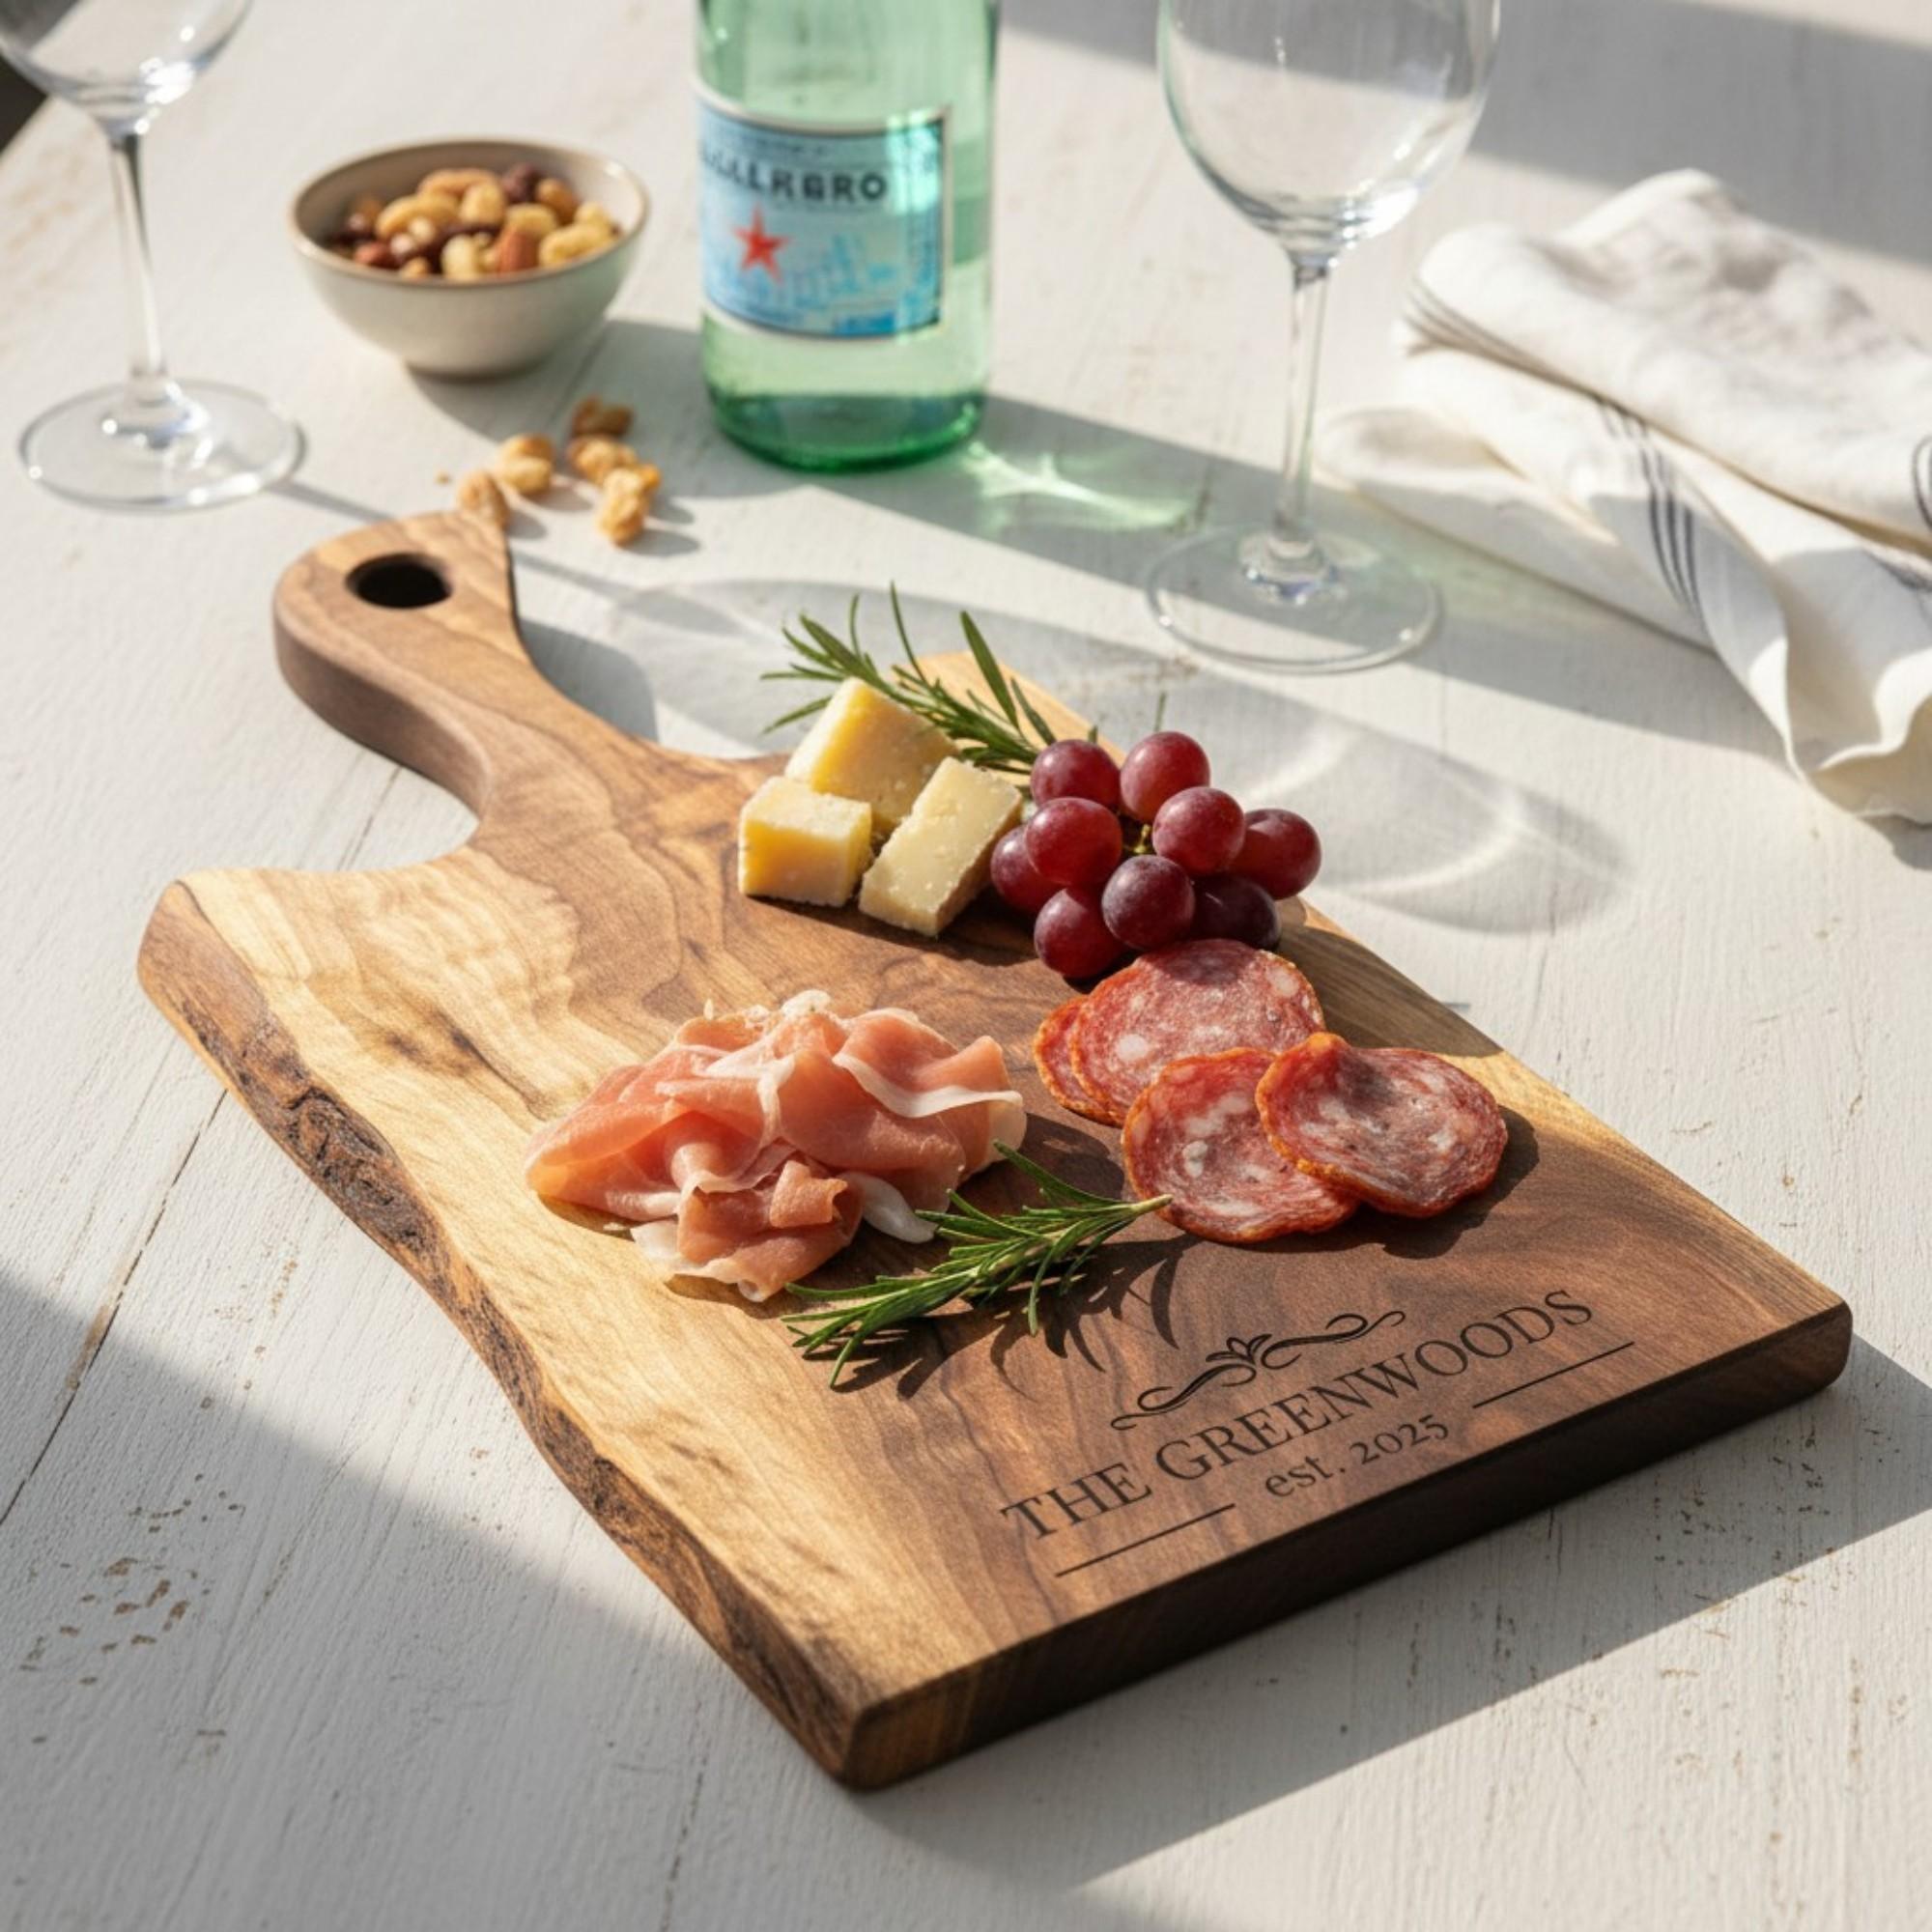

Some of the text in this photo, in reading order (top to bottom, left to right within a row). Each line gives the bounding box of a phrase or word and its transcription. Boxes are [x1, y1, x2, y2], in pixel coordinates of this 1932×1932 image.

[1000, 1290, 1593, 1540] THE GREENWOODS
[1264, 1414, 1449, 1498] est. 2025
